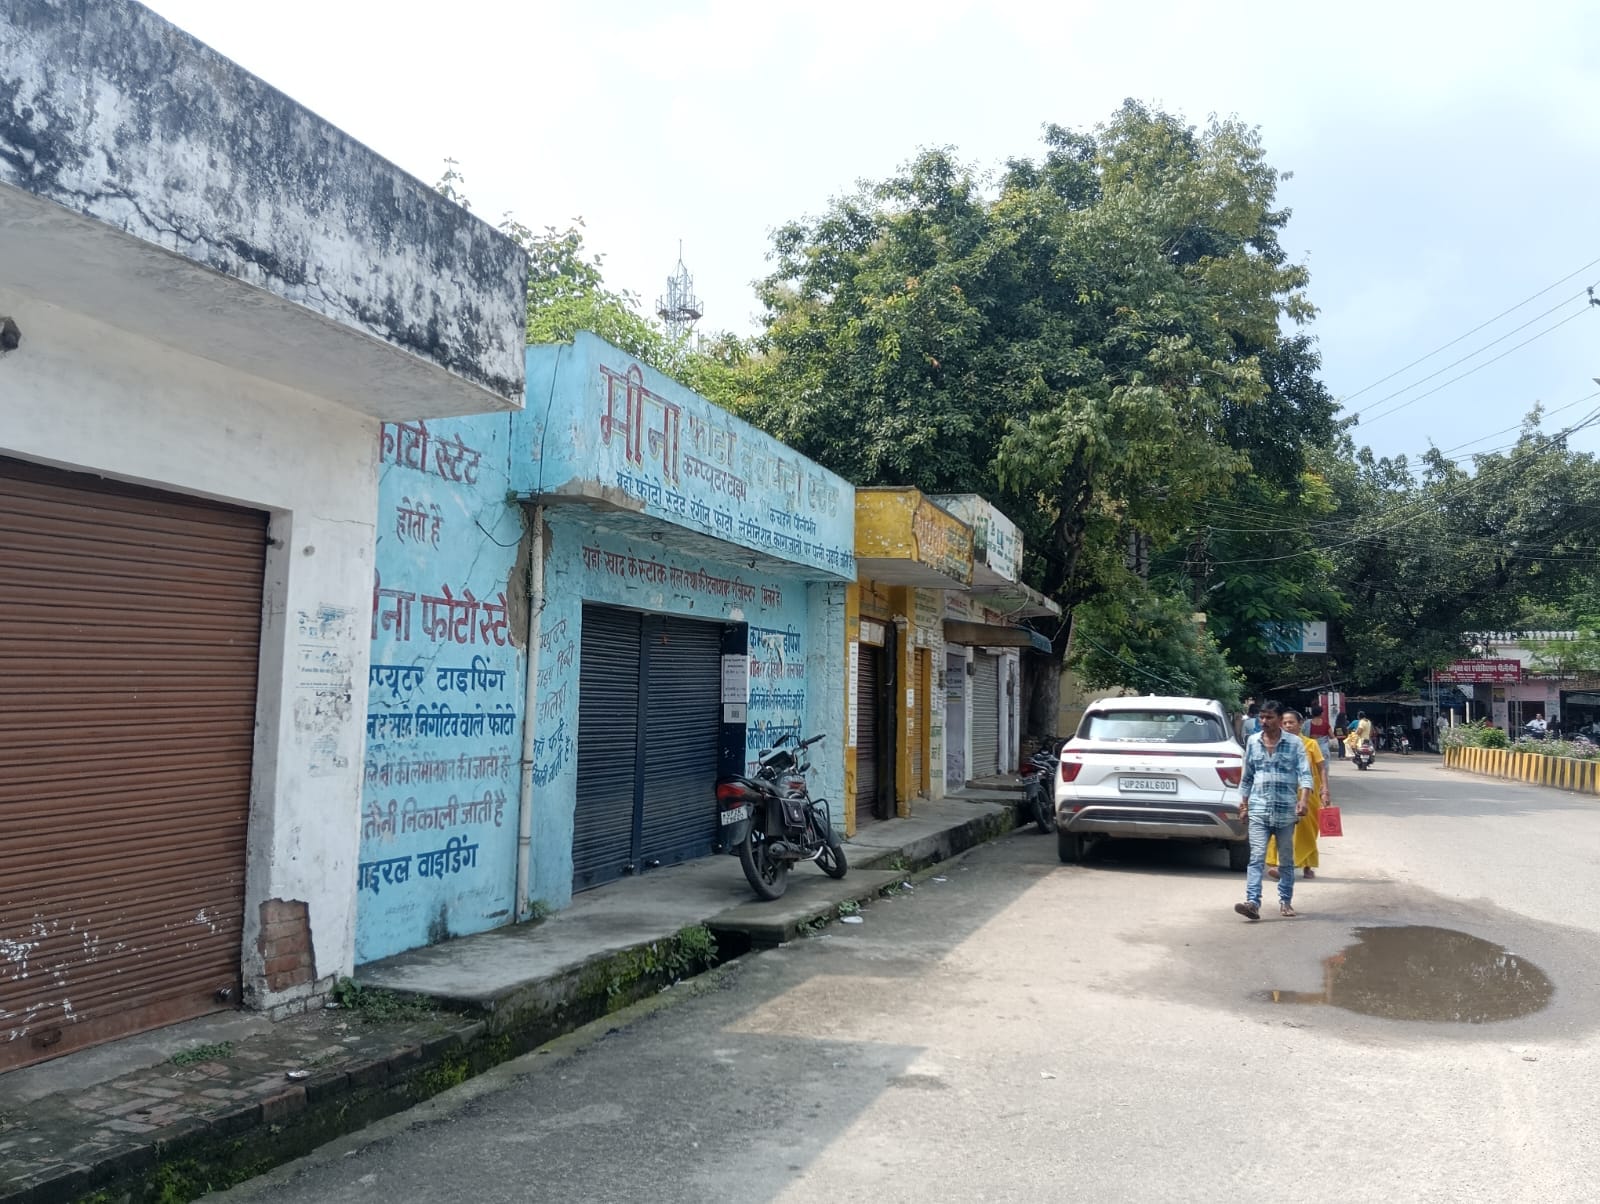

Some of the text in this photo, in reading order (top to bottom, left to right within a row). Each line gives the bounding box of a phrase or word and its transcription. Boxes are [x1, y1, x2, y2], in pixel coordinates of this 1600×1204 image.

[600, 363, 682, 484] मीना
[435, 432, 481, 485] स्टेट
[396, 496, 429, 544] होती
[635, 474, 662, 505] फोटो
[665, 486, 686, 513] स्टेट
[690, 495, 710, 523] रंगीन
[712, 504, 733, 533] फोटो
[371, 568, 415, 641] ीना
[421, 583, 480, 644] फोटो
[480, 592, 515, 648] स्टे
[437, 655, 506, 694] टाइपिंग
[460, 704, 486, 738] वाले
[487, 704, 517, 737] फोटो
[361, 798, 399, 841] तौनी
[401, 796, 460, 834] निकाली
[461, 790, 493, 825] जाती
[417, 835, 479, 879] वाइडिंग
